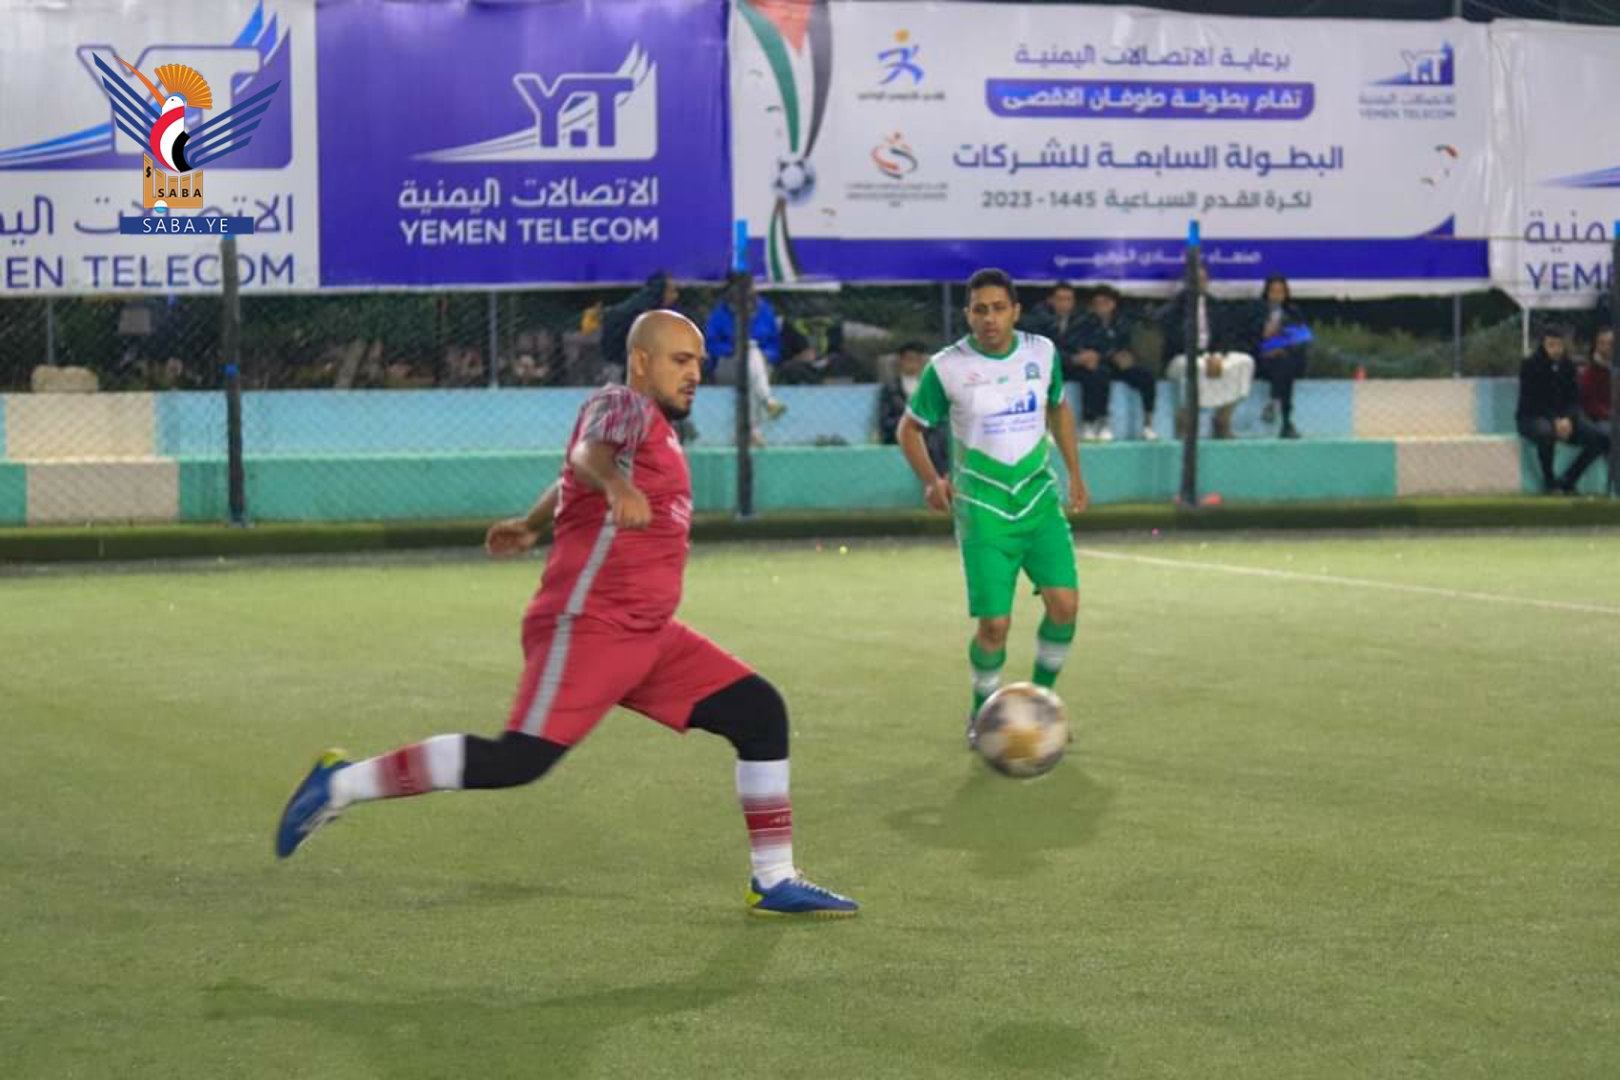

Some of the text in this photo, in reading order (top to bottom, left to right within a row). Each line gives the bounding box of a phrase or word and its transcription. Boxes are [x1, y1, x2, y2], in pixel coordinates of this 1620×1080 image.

[1014, 43, 1290, 71] برعاية الاتصالات اليمنية
[953, 138, 1343, 177] البطولة السابعة للشركات
[398, 177, 658, 216] الاتصالات اليمنية
[400, 217, 659, 245] YEMEN TELECOM
[83, 253, 294, 288] TELECOM
